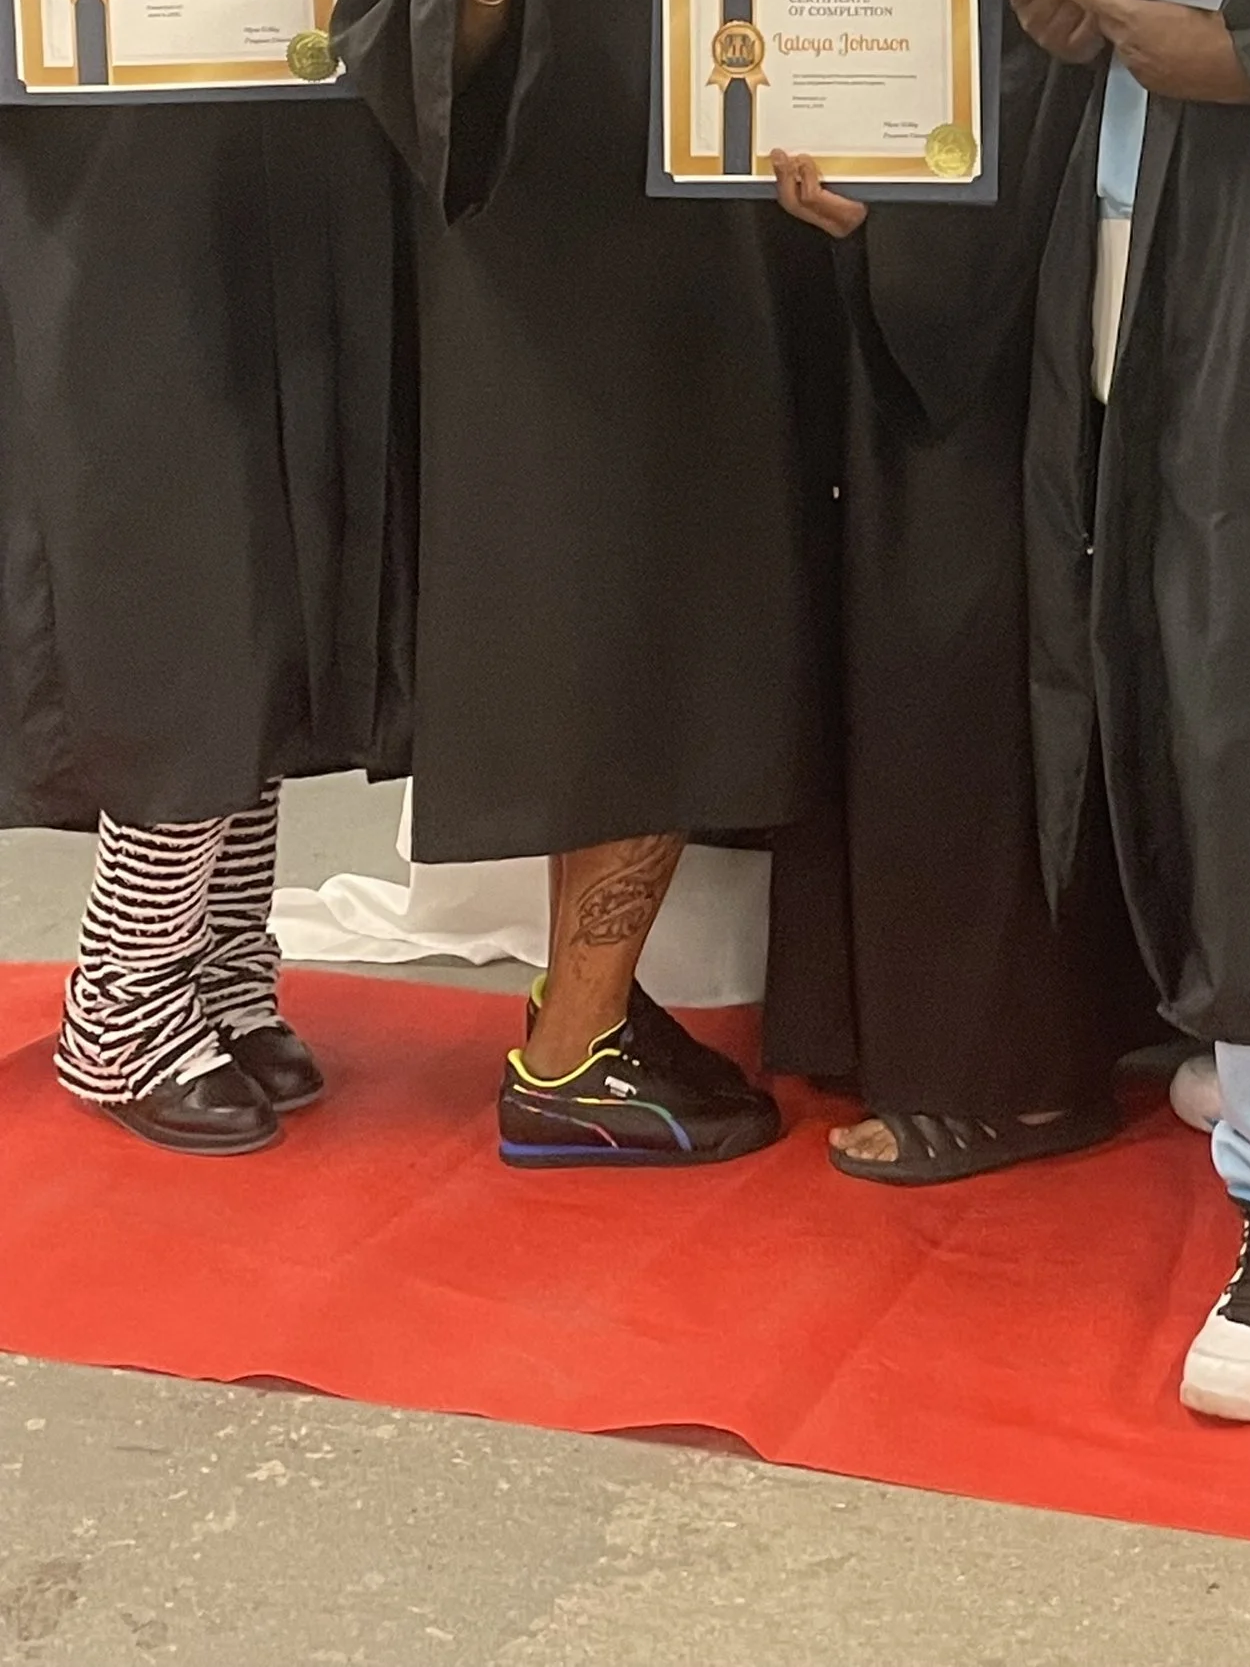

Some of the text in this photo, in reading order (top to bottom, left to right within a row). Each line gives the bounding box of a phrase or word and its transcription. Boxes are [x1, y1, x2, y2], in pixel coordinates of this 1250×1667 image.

[788, 6, 893, 17] OF COMPLETION
[837, 32, 911, 57] Johnson
